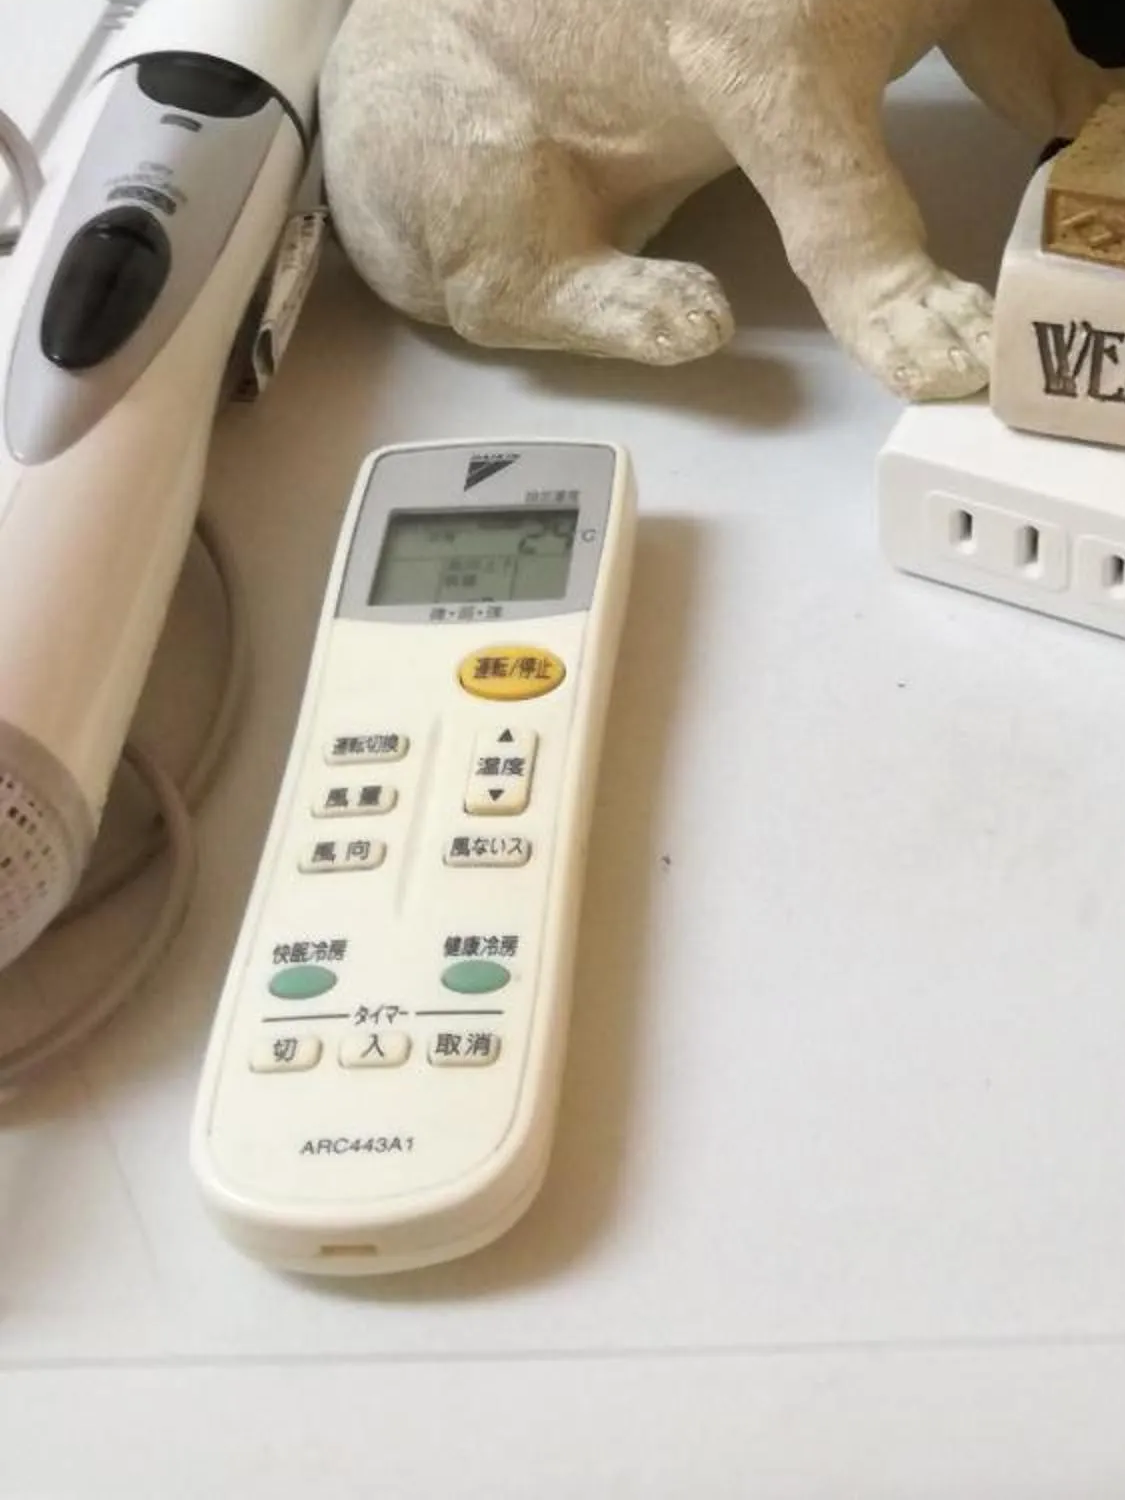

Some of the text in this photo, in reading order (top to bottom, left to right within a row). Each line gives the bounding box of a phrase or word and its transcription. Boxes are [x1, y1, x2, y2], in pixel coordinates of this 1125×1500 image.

[443, 935, 519, 957] 健康冷房
[351, 1004, 409, 1025] タイマー
[273, 1038, 298, 1062] 切
[360, 1033, 385, 1058] 入
[435, 1033, 492, 1056] 取消
[300, 1136, 415, 1155] ARC443A1
